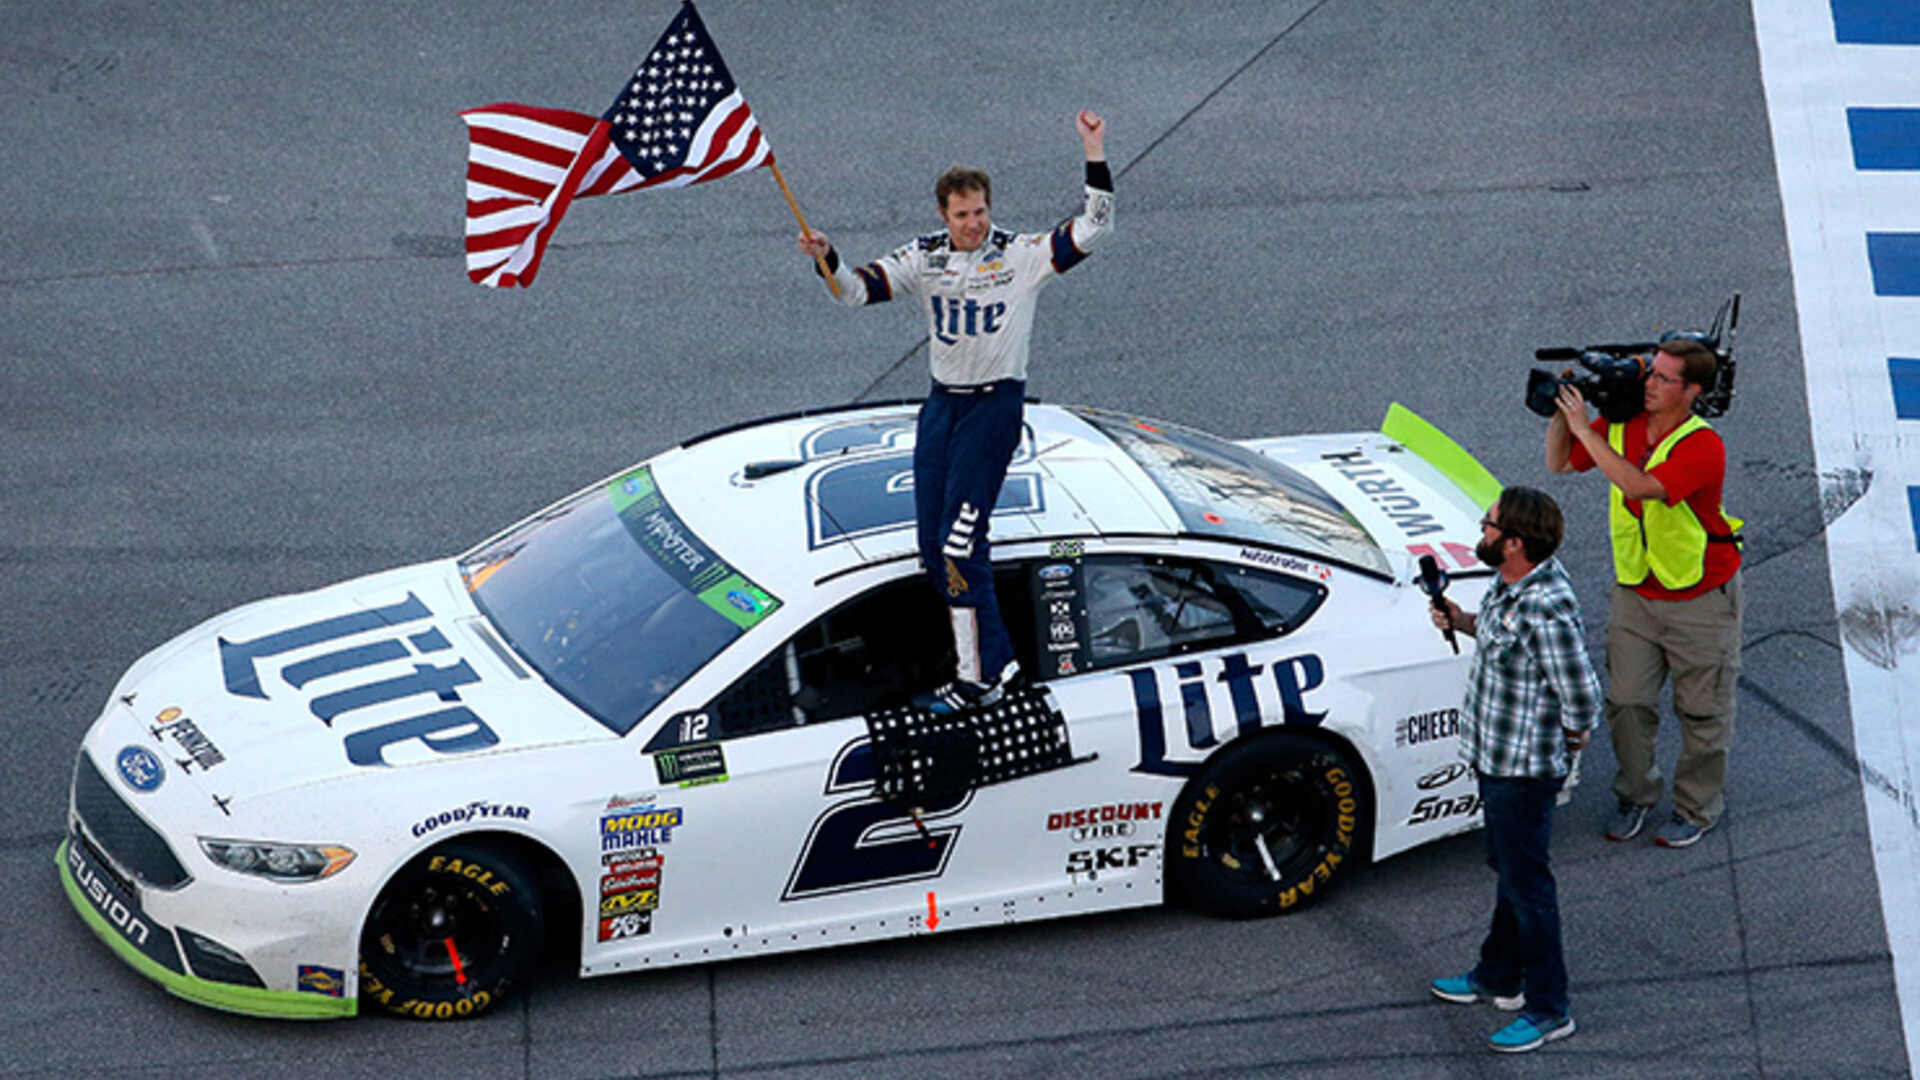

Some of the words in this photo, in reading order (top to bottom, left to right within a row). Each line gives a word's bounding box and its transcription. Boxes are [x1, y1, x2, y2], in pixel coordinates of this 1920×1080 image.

[931, 296, 1006, 345] Lite
[1321, 450, 1444, 537] WÜRTH
[943, 502, 979, 558] Lite
[217, 592, 500, 768] Lite
[684, 713, 709, 741] 12
[1122, 653, 1329, 778] Lite
[119, 749, 160, 787] Ford
[412, 801, 531, 838] GOODYEAR
[605, 809, 678, 832] MOOG
[780, 735, 963, 900] 2
[1047, 802, 1163, 831] DISCOUNT
[1077, 822, 1128, 841] TIRE
[1183, 785, 1219, 857] EAGLE
[602, 828, 672, 850] MAHLE
[428, 855, 511, 895] EAGLE
[1066, 845, 1160, 875] SKF
[69, 842, 149, 944] FUSION
